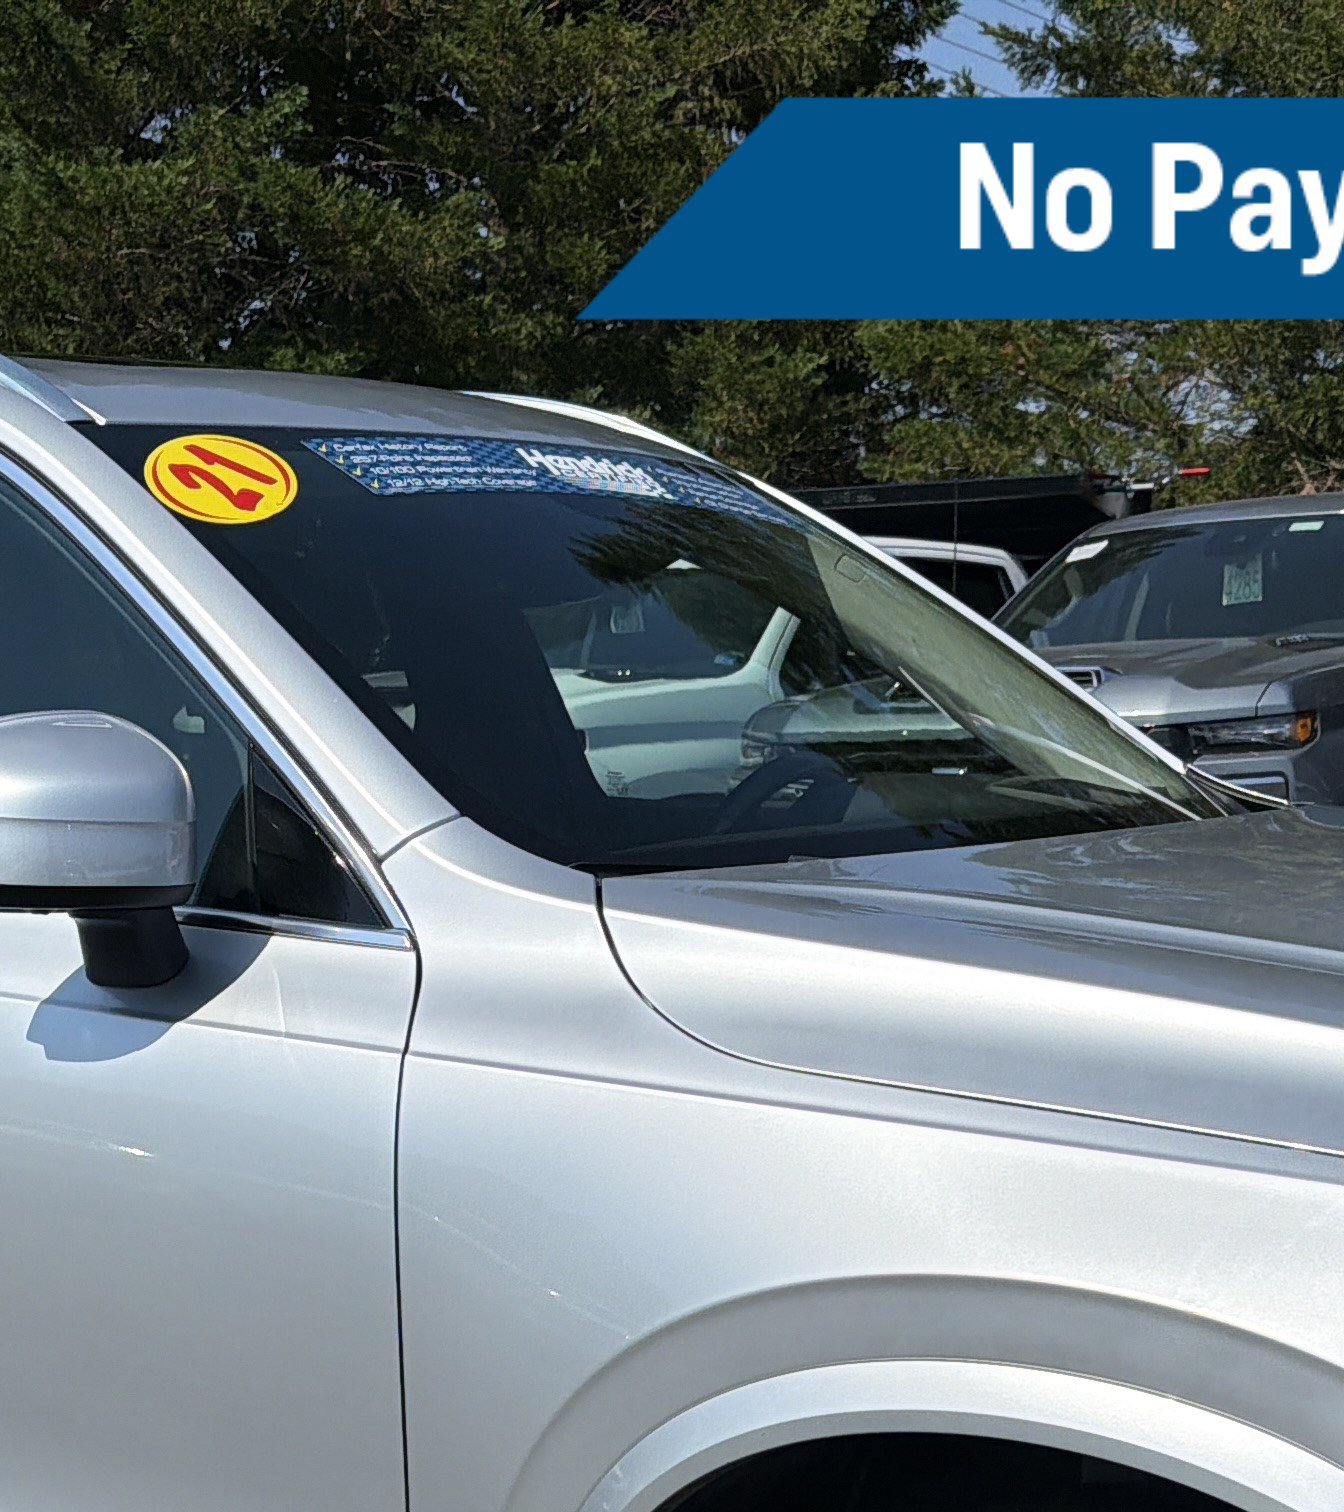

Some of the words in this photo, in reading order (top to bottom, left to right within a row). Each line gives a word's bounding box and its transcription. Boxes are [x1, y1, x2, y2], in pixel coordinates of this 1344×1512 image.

[377, 442, 423, 452] History
[424, 442, 469, 452] Report
[370, 465, 415, 475] 10/100
[416, 465, 482, 475] Powertrain
[515, 448, 653, 484] Hendrick
[167, 443, 279, 511] 21
[387, 477, 424, 487] 12/12
